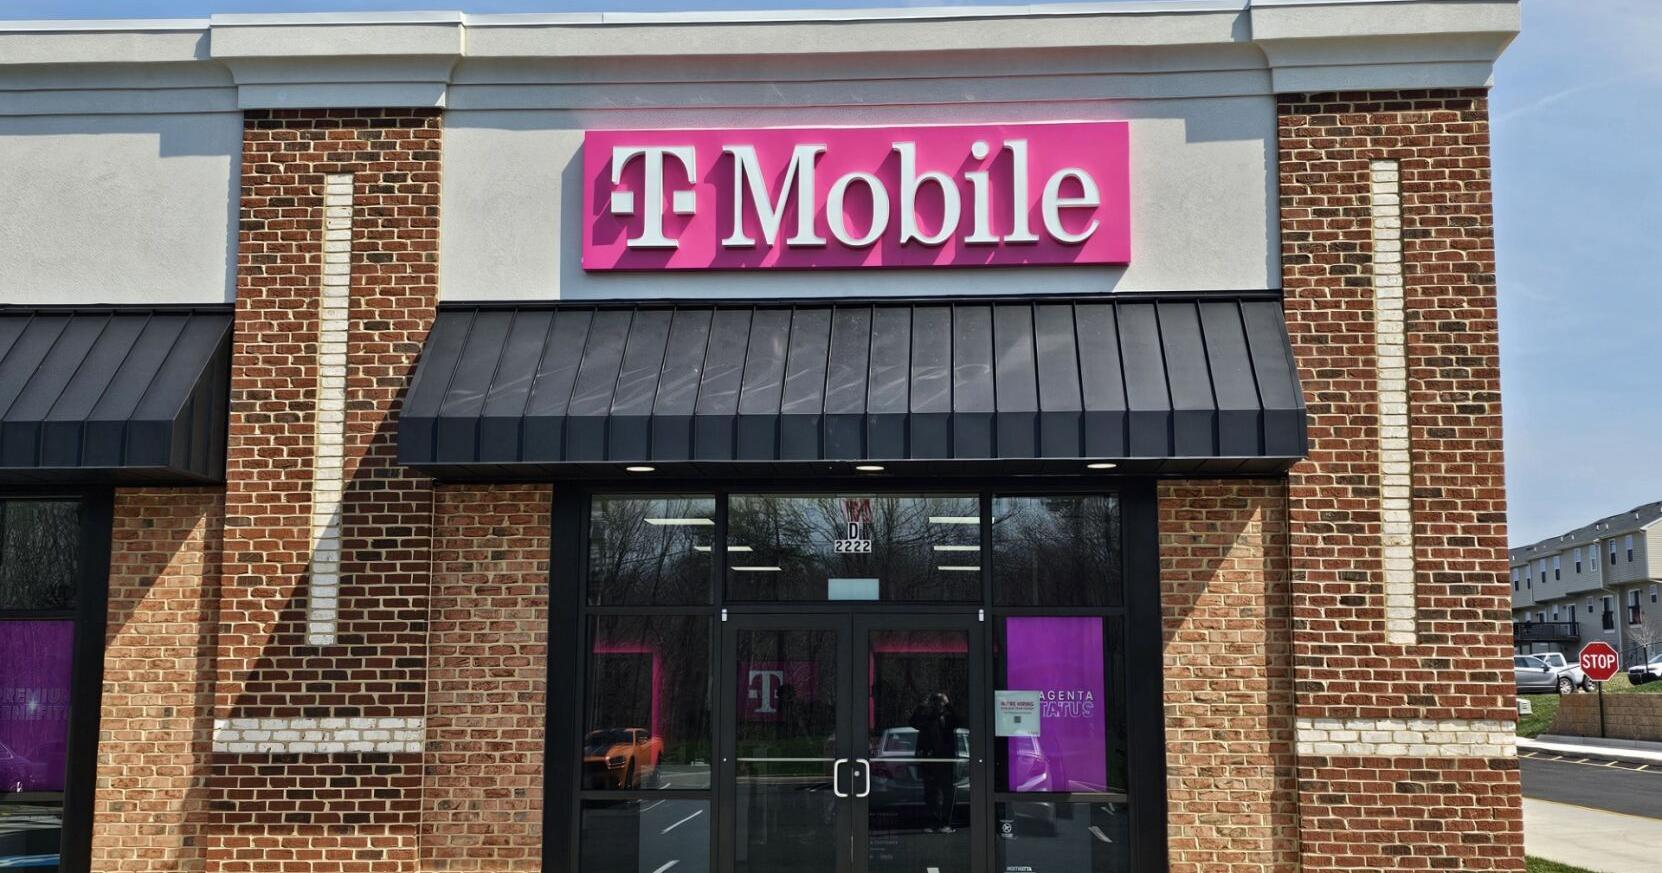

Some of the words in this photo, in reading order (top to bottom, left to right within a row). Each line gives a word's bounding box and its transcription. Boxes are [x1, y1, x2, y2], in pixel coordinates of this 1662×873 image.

[721, 139, 1100, 247] Mobile
[849, 523, 859, 539] D
[836, 541, 870, 552] 2222
[1582, 654, 1616, 669] STOP
[1040, 690, 1094, 700] AGENTA
[1040, 701, 1094, 718] TATUS
